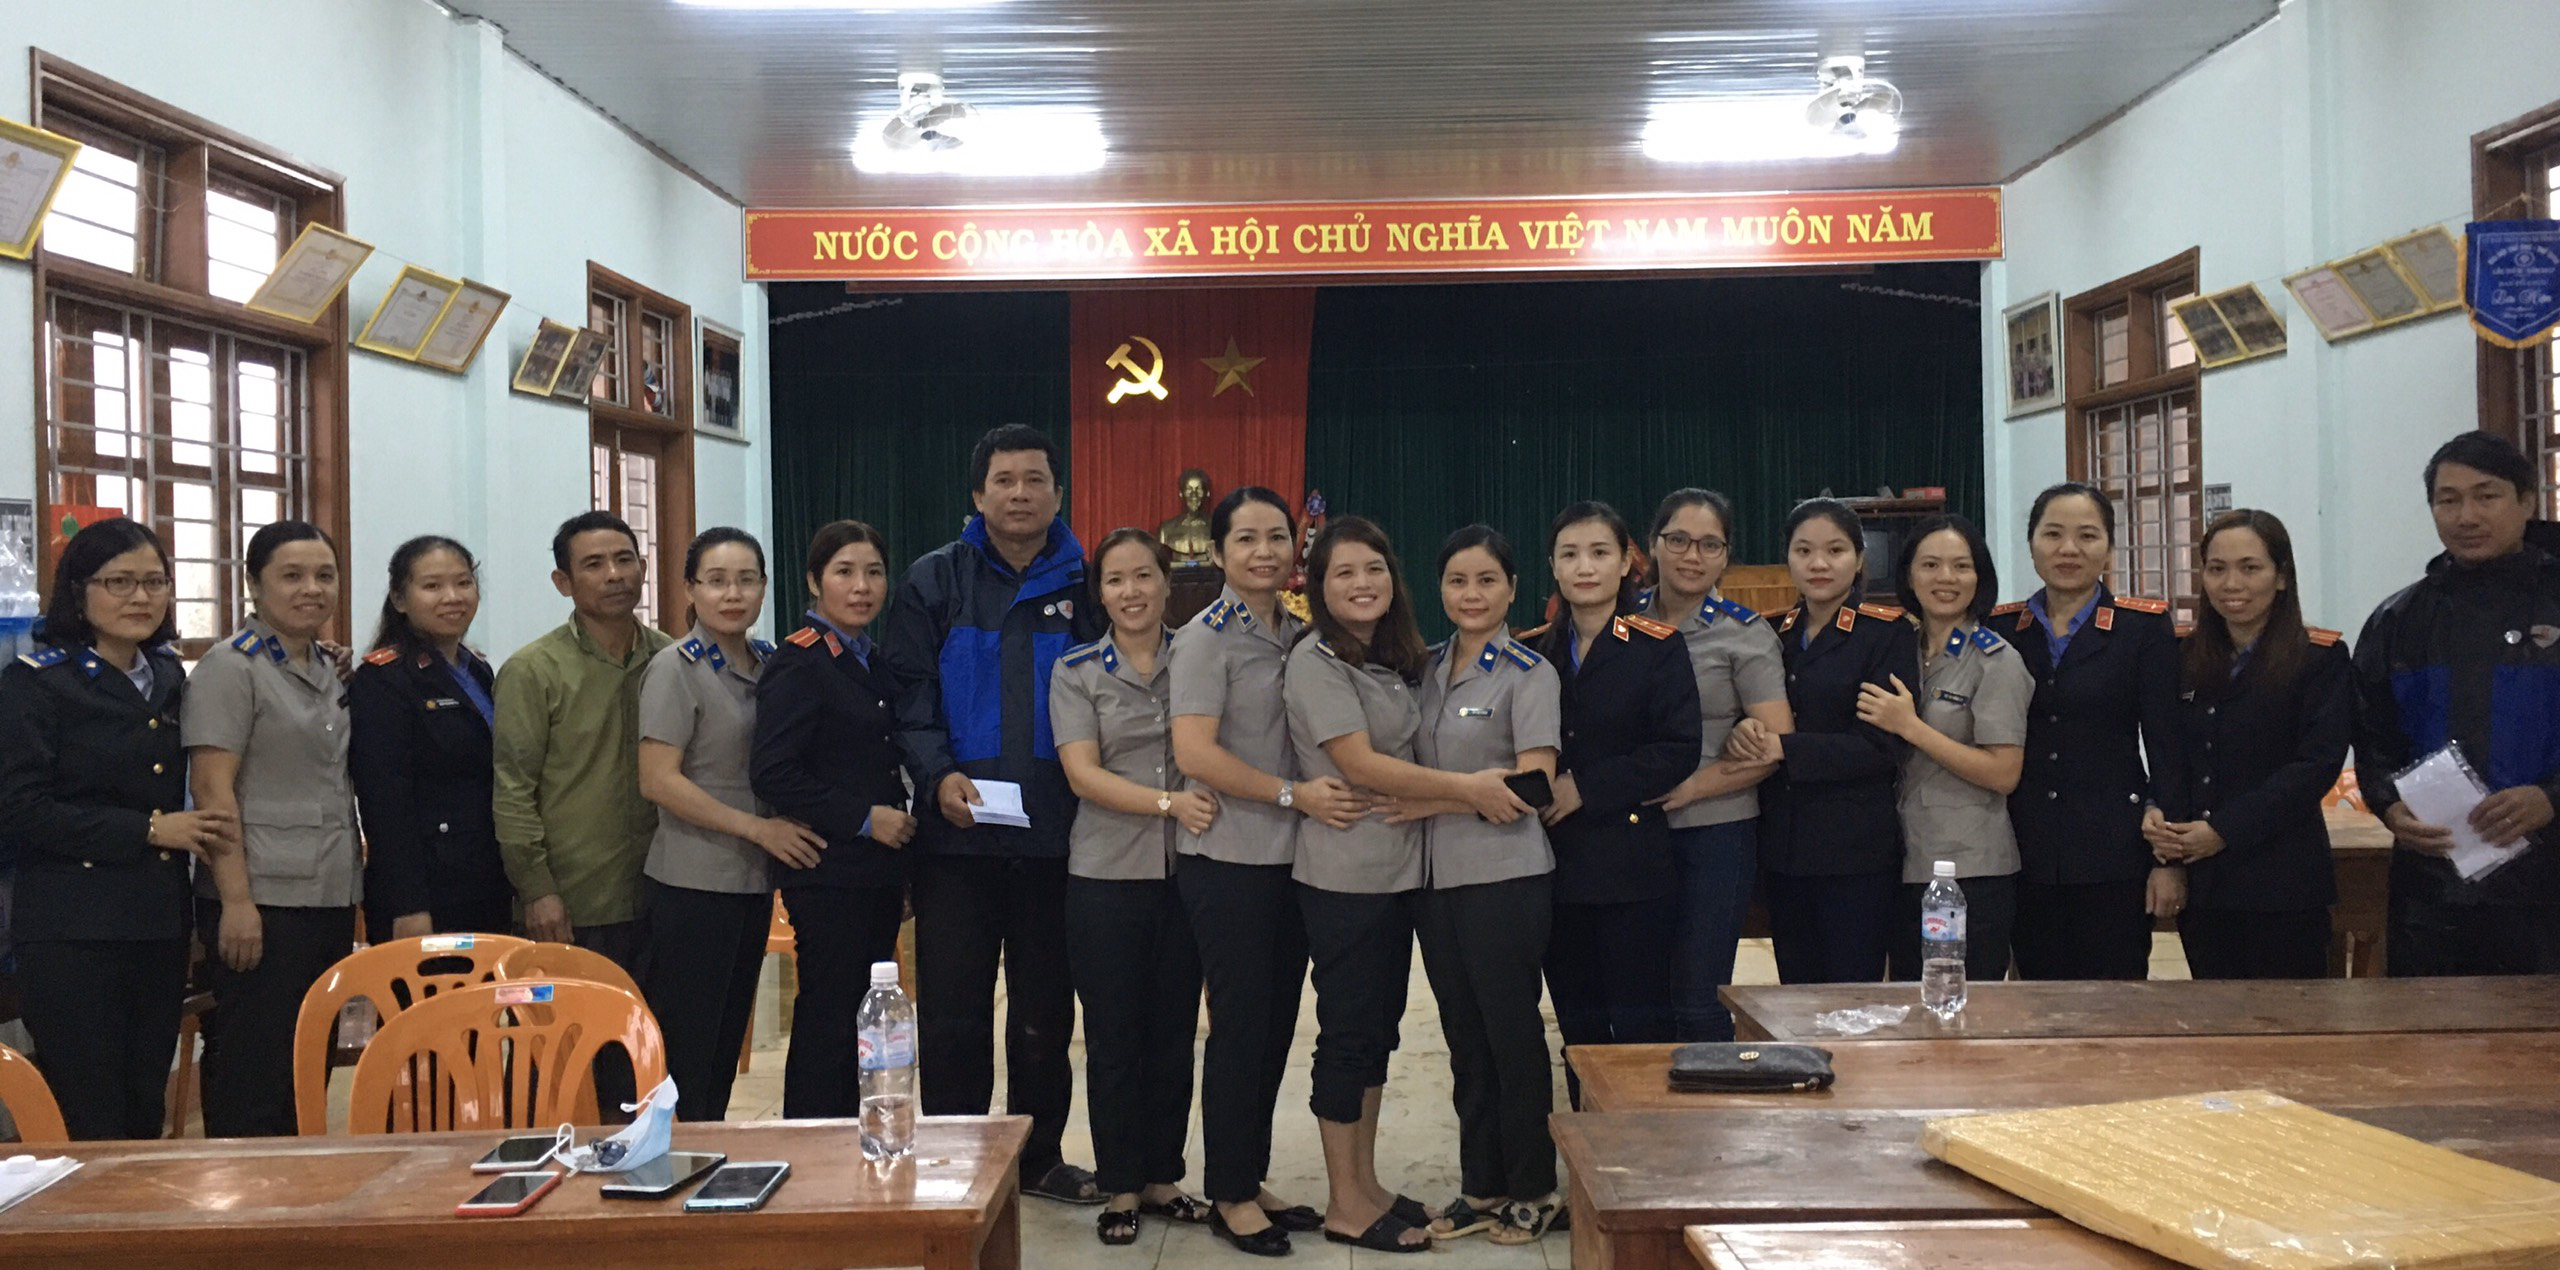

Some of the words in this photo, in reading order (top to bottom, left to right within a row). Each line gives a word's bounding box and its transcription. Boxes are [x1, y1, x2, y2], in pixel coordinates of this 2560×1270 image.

[813, 223, 918, 260] NƯỚC
[932, 222, 1038, 266] CỘNG
[1050, 220, 1134, 258] HÒA
[1144, 219, 1199, 256] XÃ
[1211, 217, 1280, 261] HỘI
[1293, 212, 1371, 254] CHỦ
[1386, 215, 1509, 252] NGHĨA
[1519, 212, 1611, 256] VIỆT
[1623, 217, 1708, 250] NAM
[1721, 207, 1834, 247] MUÔN
[1846, 205, 1934, 243] NĂM
